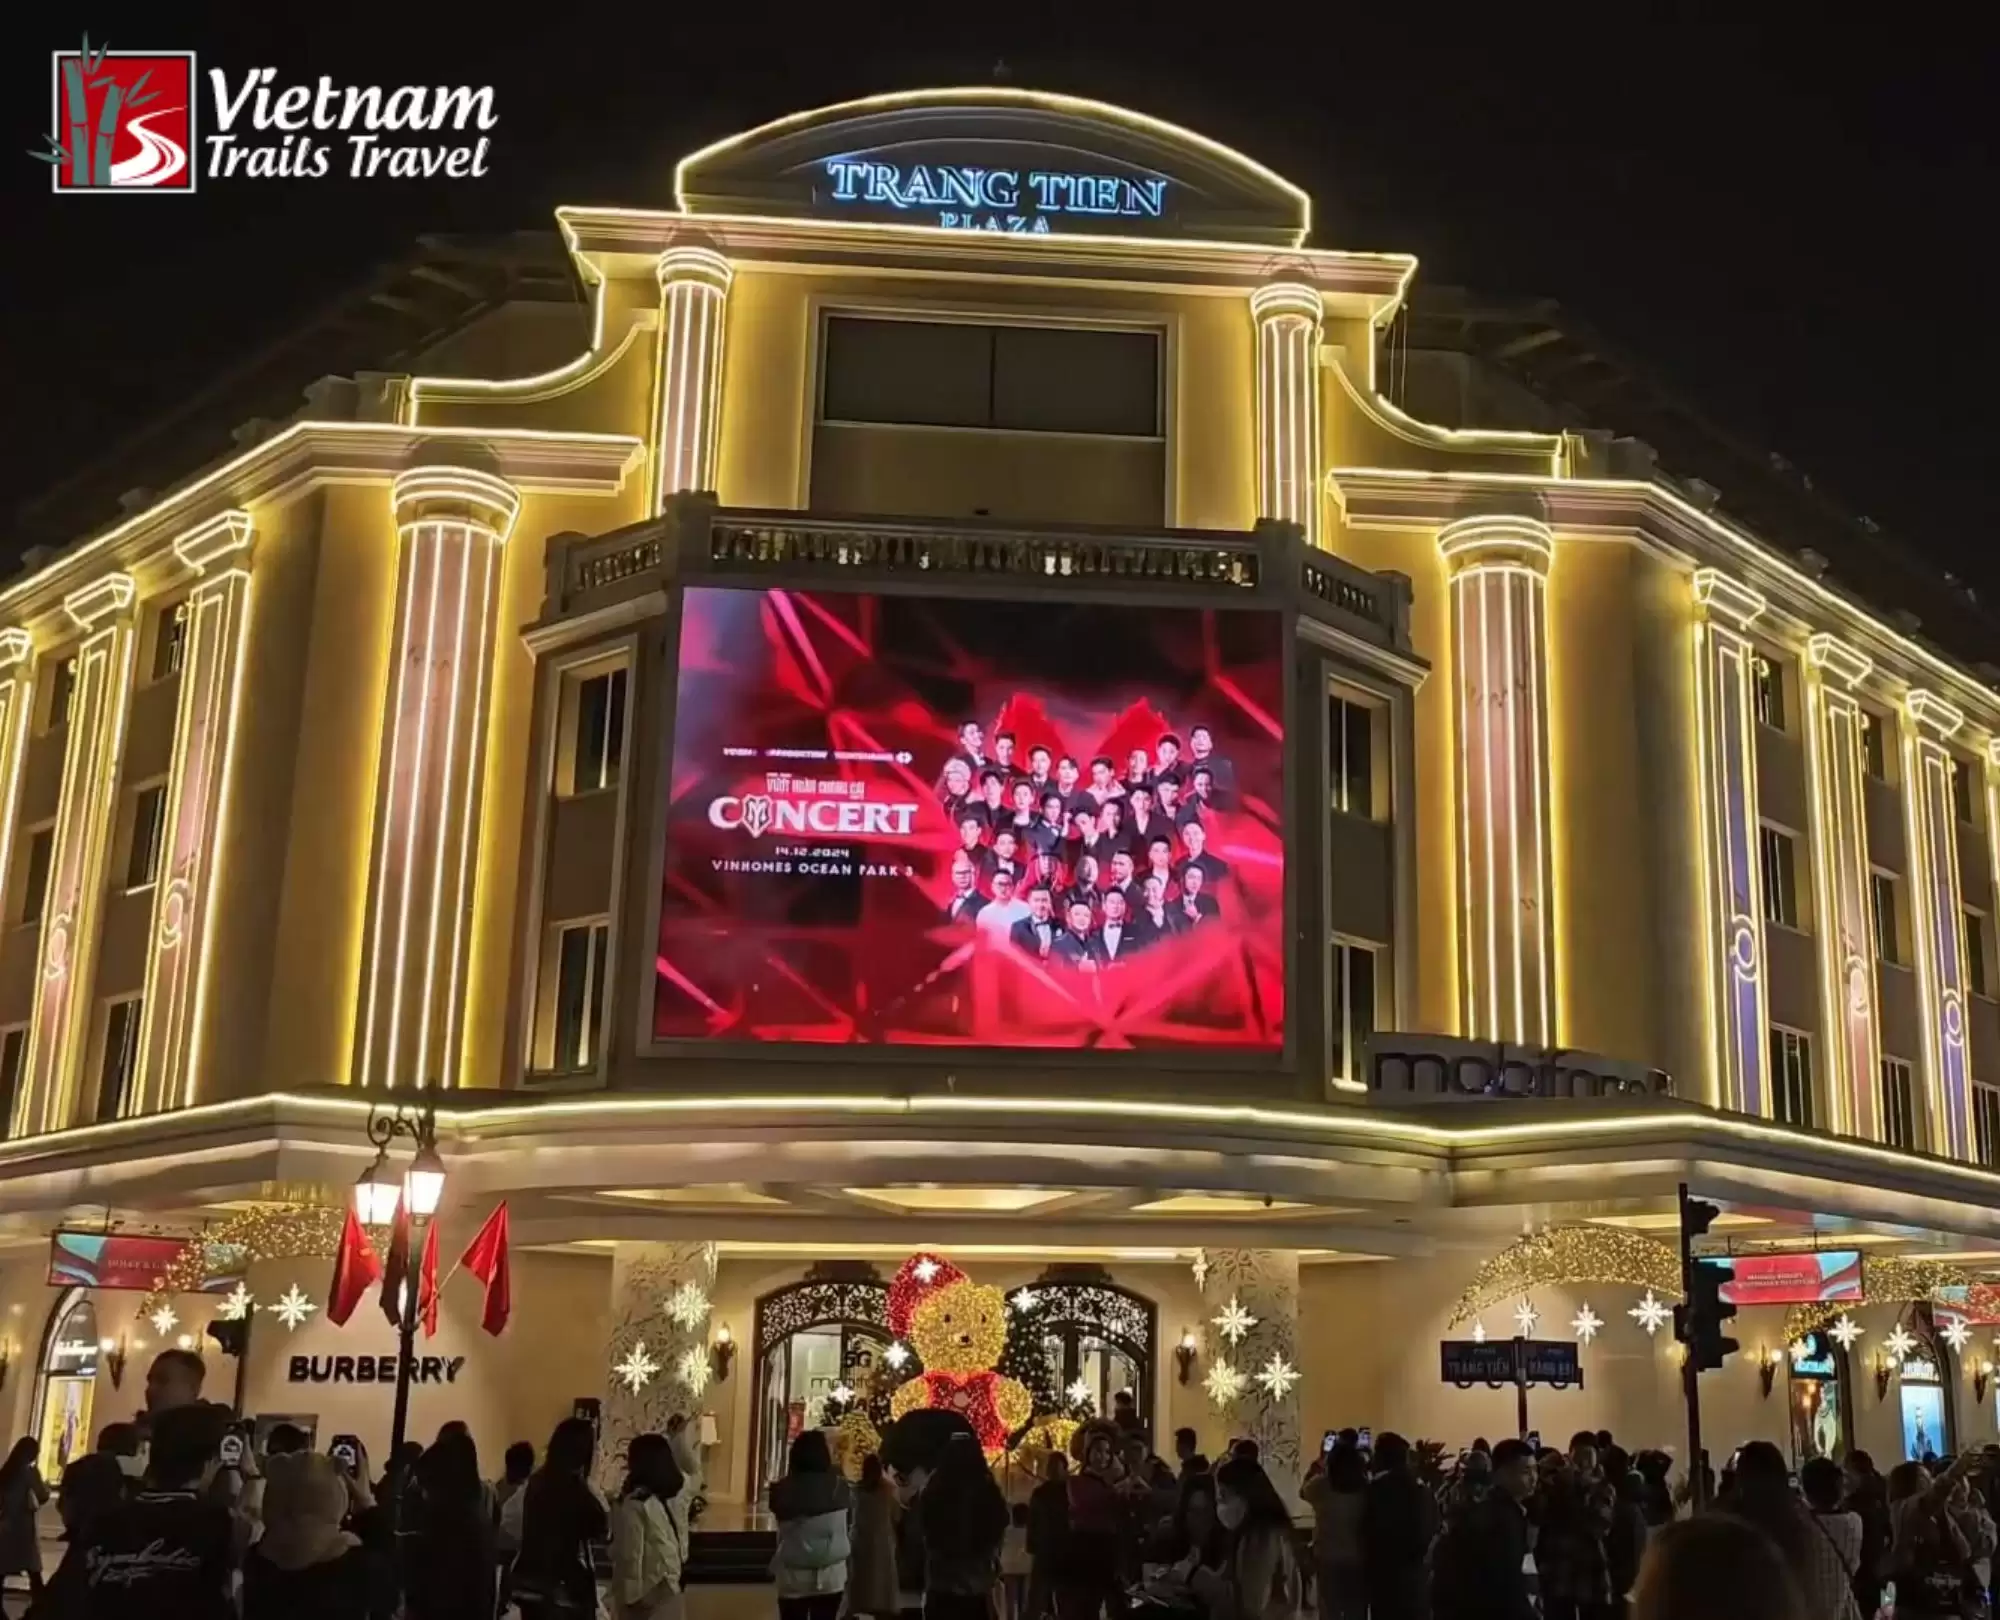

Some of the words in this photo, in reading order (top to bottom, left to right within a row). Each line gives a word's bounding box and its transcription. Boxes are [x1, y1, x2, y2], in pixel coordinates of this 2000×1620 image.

[826, 160, 1019, 208] TRANG
[1029, 171, 1167, 217] TIEN
[940, 211, 1051, 234] PLAZA
[775, 846, 850, 858] 14.12.2024
[712, 860, 792, 874] VINHOMES
[799, 862, 852, 876] OCEAN
[859, 864, 899, 876] PARK
[288, 1355, 466, 1384] BURBERRY
